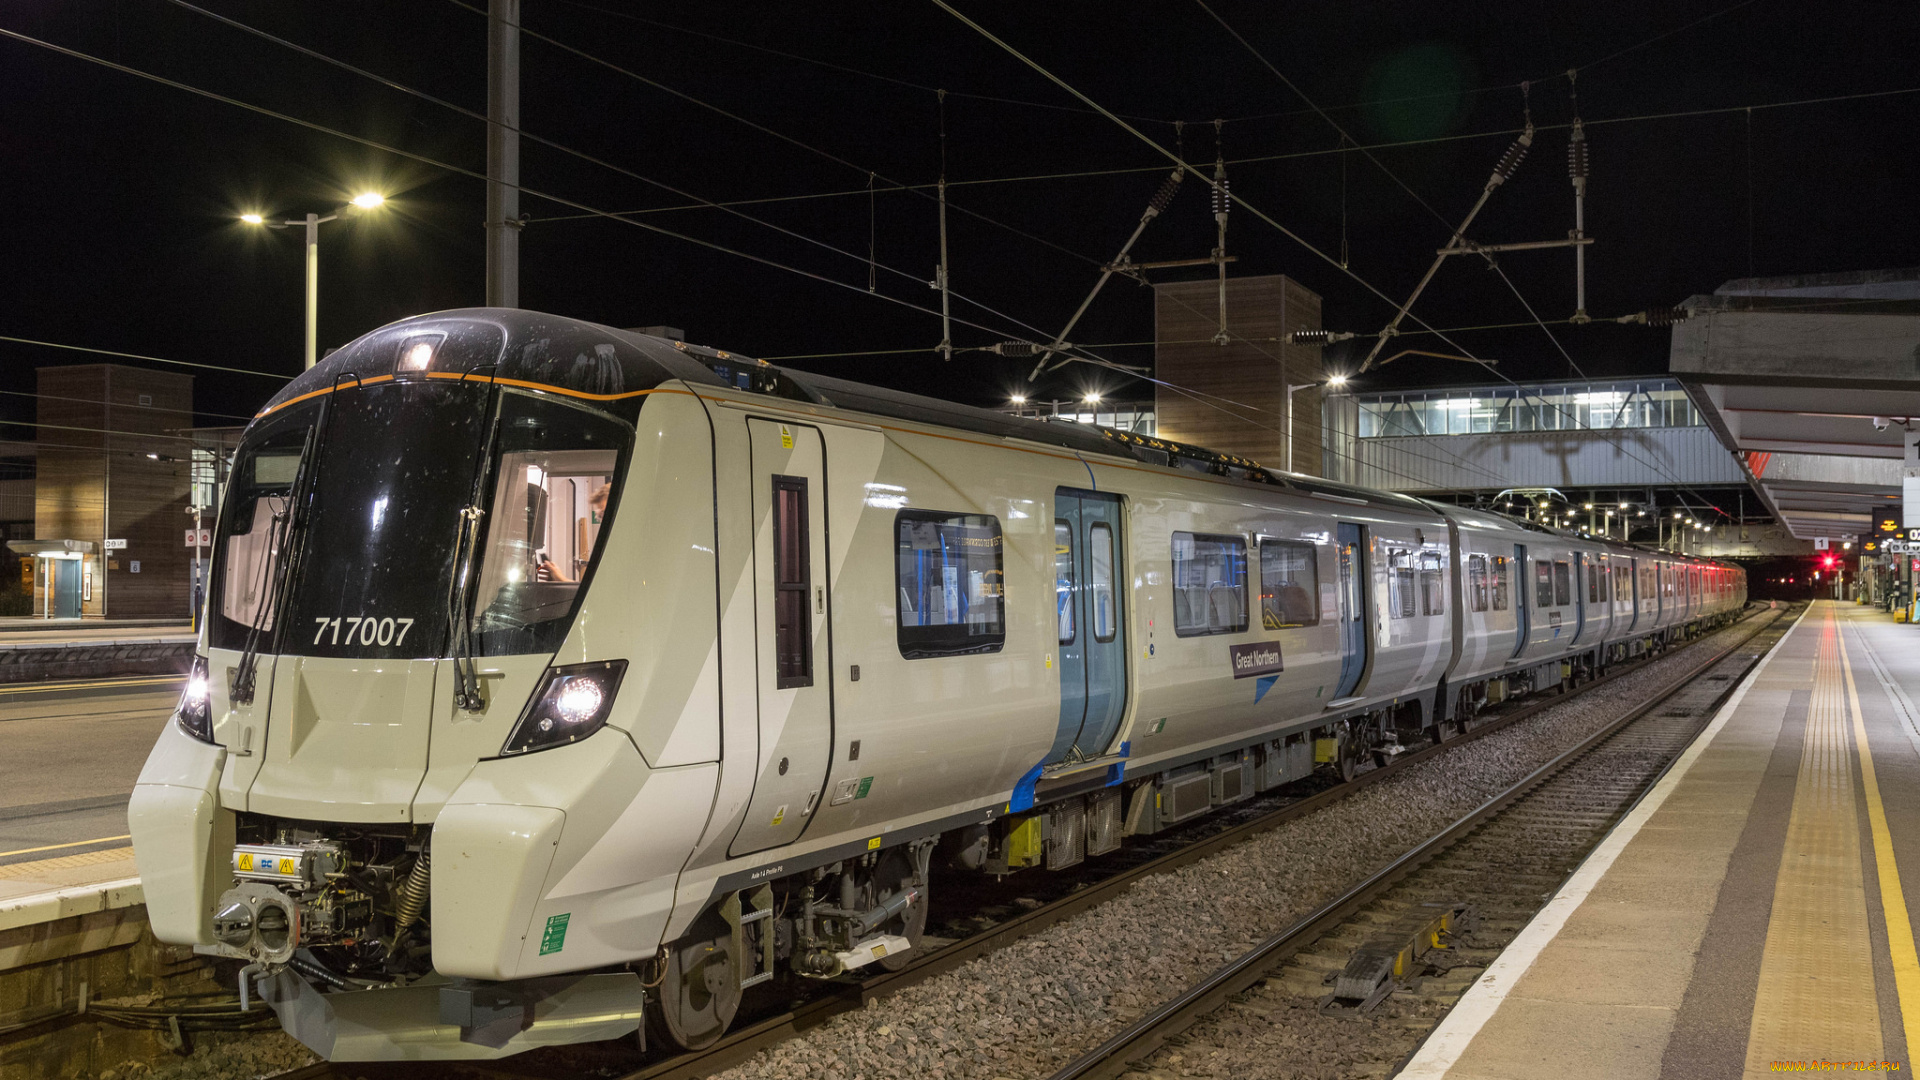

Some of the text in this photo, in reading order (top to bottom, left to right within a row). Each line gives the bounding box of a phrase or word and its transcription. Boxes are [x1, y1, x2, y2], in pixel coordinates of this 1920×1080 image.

[313, 617, 414, 647] 717007
[1236, 649, 1279, 669] Great Northern
